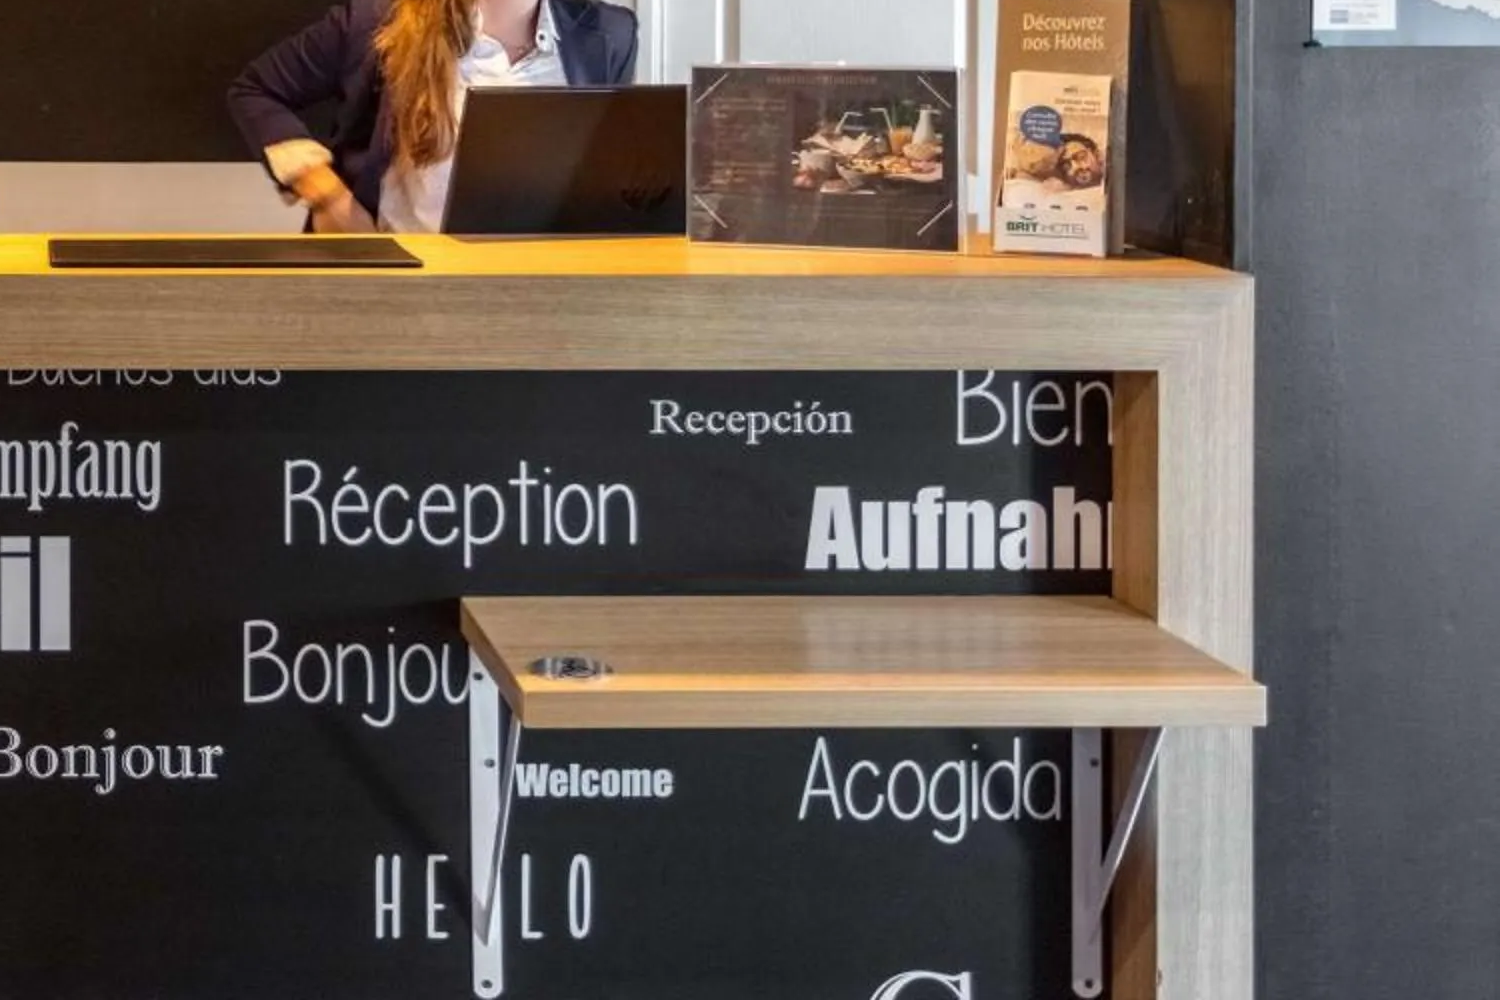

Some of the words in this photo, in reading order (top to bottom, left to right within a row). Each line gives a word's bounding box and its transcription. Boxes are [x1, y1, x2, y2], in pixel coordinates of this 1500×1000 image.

[1022, 13, 1106, 32] Découvrez
[1022, 36, 1051, 50] nos
[1054, 34, 1105, 50] Hôtels
[1006, 221, 1040, 233] BRIT
[650, 400, 852, 445] Recepción
[957, 369, 1113, 446] Bien
[285, 460, 637, 568] Réception
[805, 486, 1113, 571] Aufnah
[514, 763, 673, 797] Welcome
[798, 736, 1061, 844] Acogida
[376, 854, 591, 939] HELO
